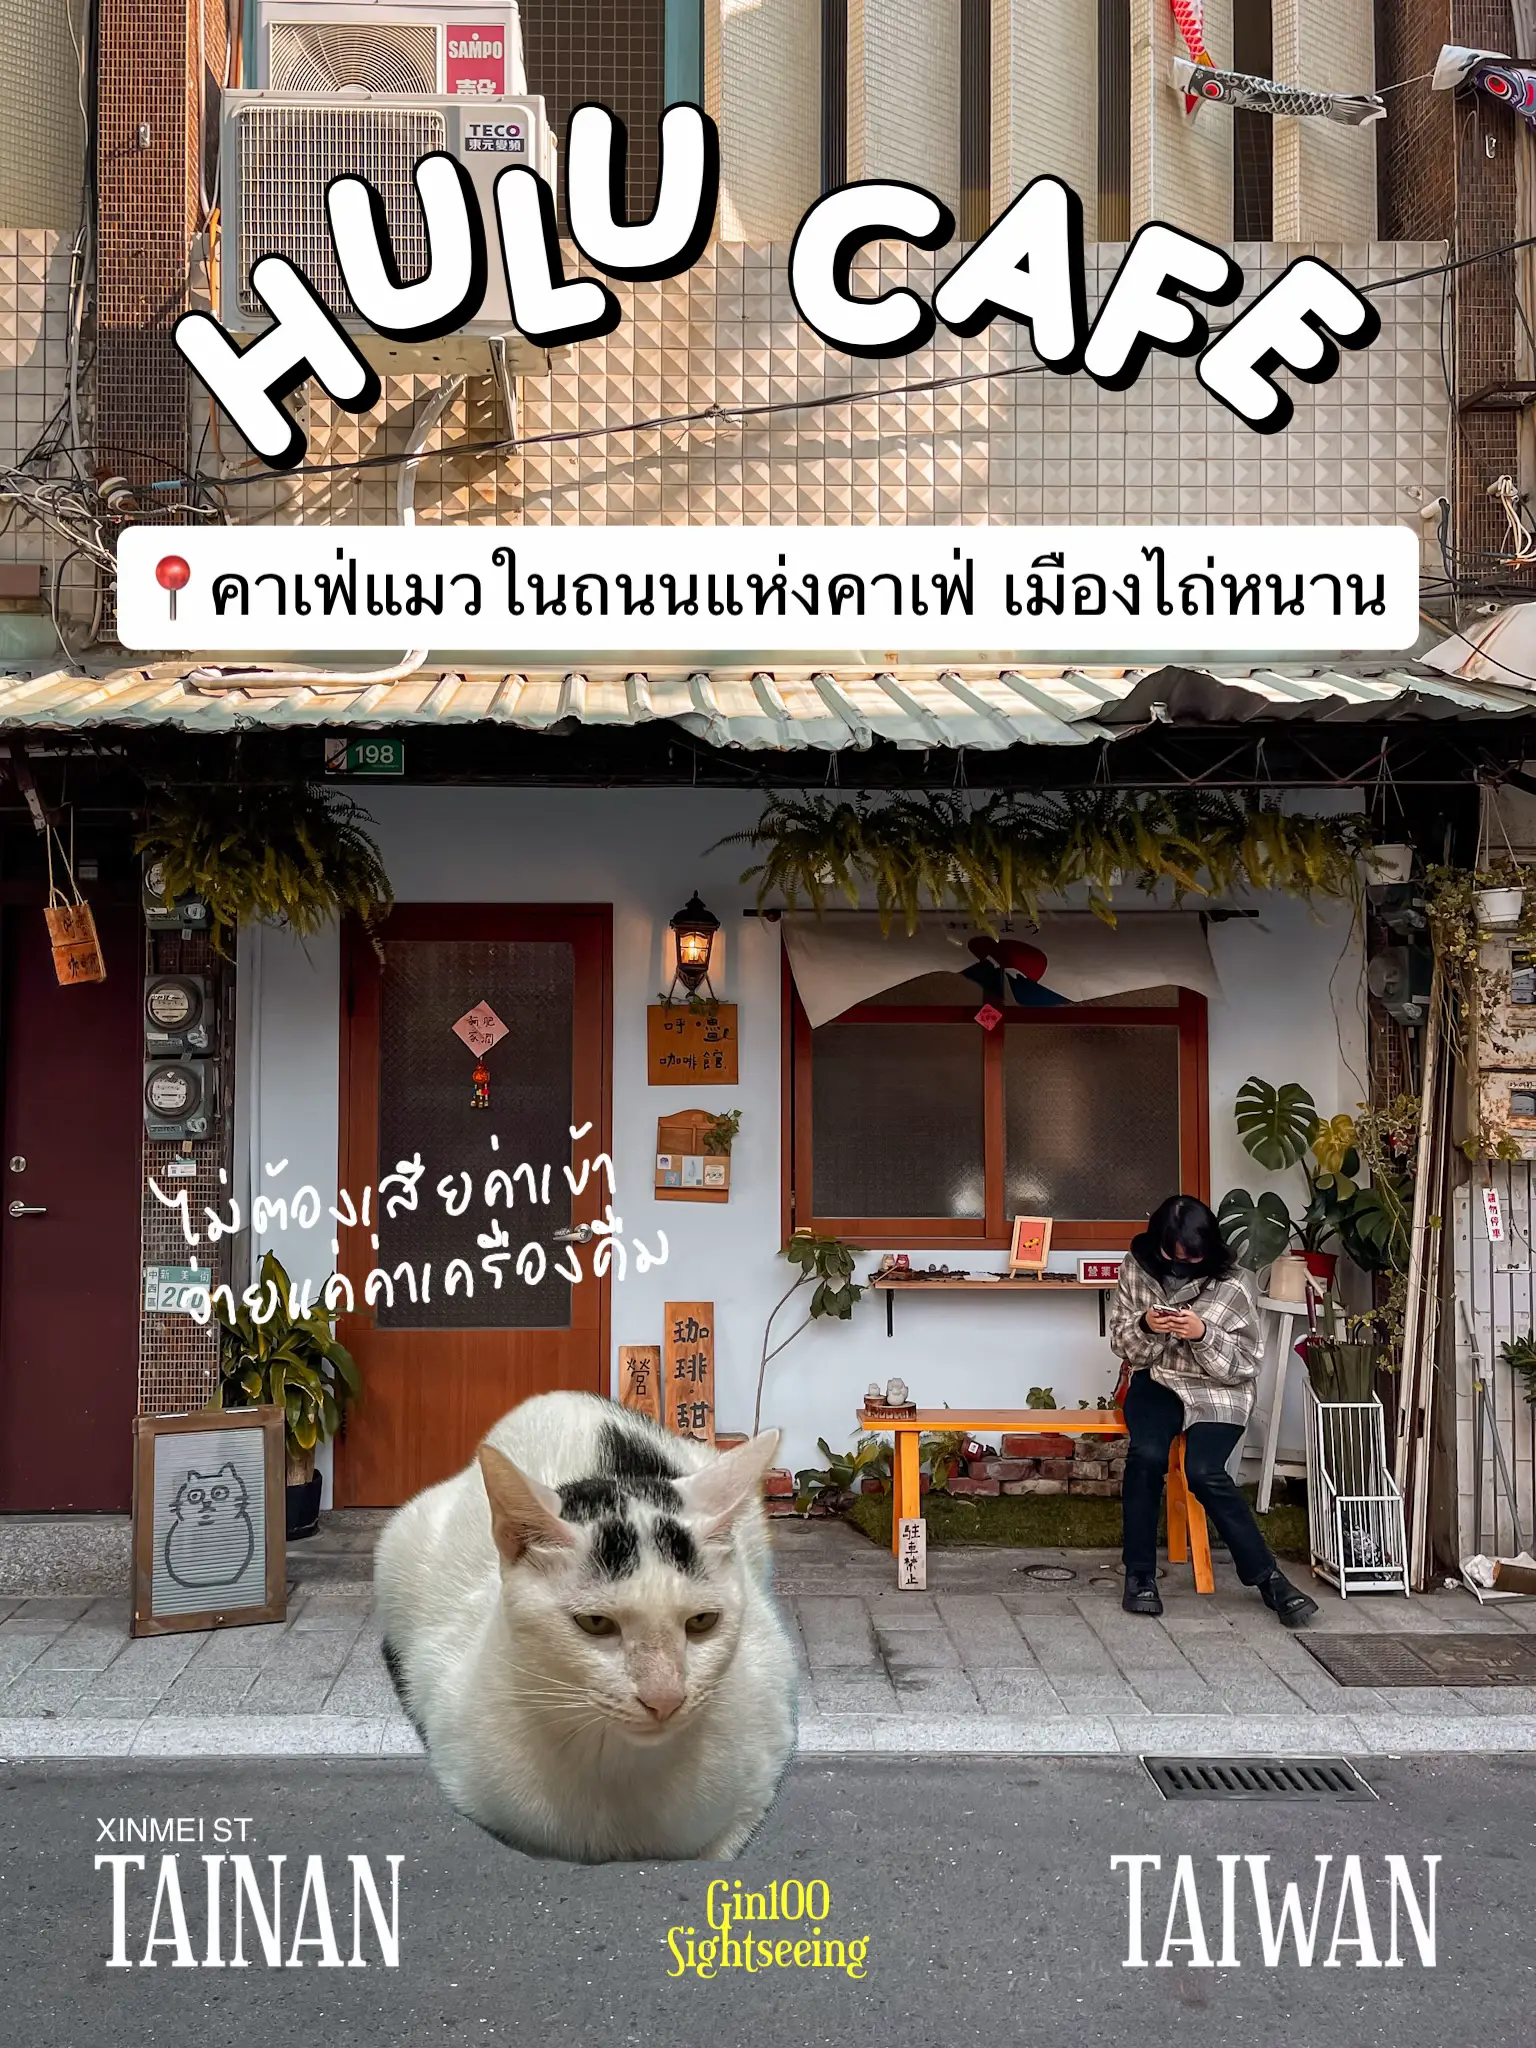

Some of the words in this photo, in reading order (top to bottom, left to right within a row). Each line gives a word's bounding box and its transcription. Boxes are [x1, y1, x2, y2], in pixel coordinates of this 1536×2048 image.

[448, 32, 503, 59] SAMPO
[469, 124, 520, 137] TECO
[468, 139, 521, 152] 東元變頻
[355, 745, 394, 764] 198
[160, 1268, 210, 1283] 新美街
[902, 1523, 921, 1585] 駐車禁止
